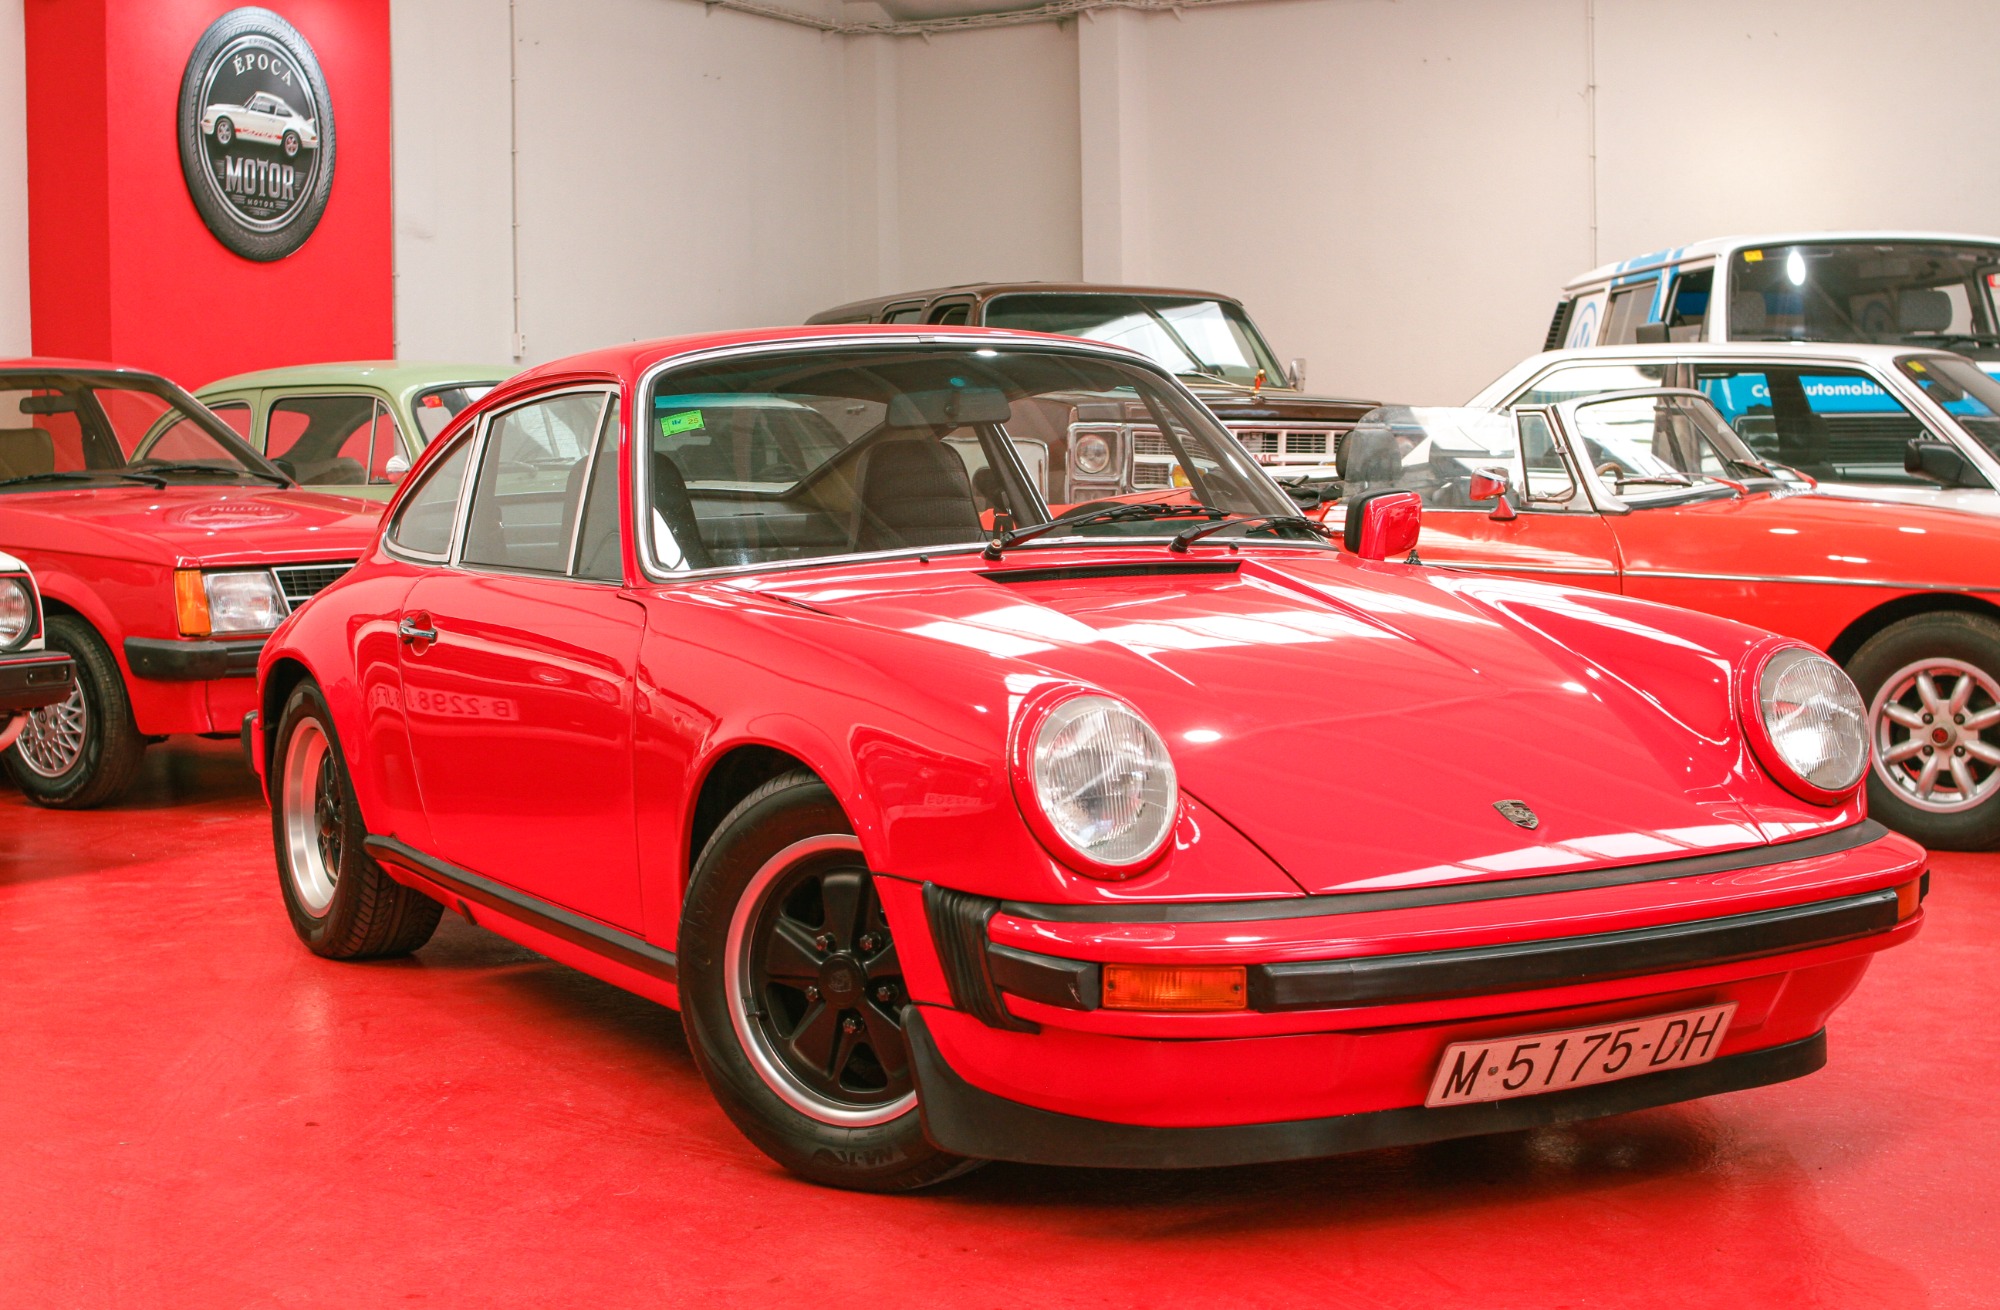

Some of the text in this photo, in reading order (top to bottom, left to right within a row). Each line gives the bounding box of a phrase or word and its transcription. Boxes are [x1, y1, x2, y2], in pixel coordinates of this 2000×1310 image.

[233, 54, 292, 86] ÉPOCA
[225, 155, 294, 200] MOTOR
[247, 198, 275, 208] MOTOR
[1803, 380, 1885, 396] utomobi
[1253, 454, 1279, 464] MC
